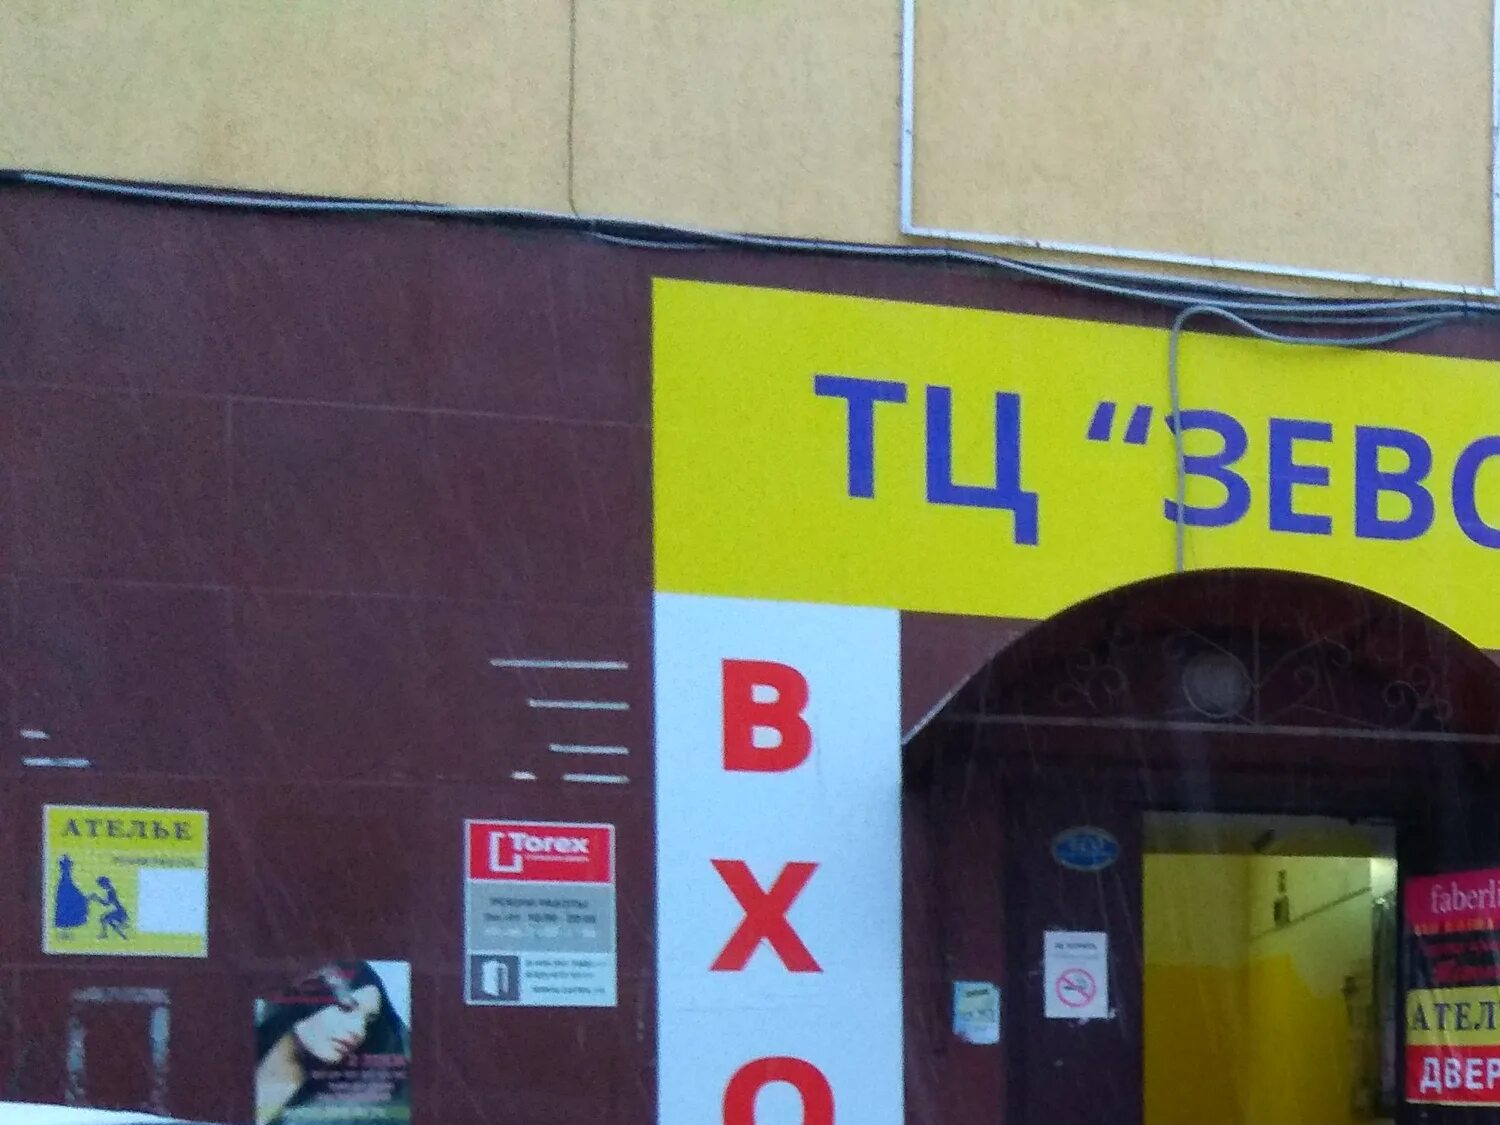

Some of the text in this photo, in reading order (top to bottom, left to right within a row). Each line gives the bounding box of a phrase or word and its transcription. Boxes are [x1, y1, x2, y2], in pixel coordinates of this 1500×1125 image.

[814, 375, 1038, 546] ТЦ
[62, 817, 193, 841] АТЕЛЬЕ
[507, 831, 590, 854] Torex
